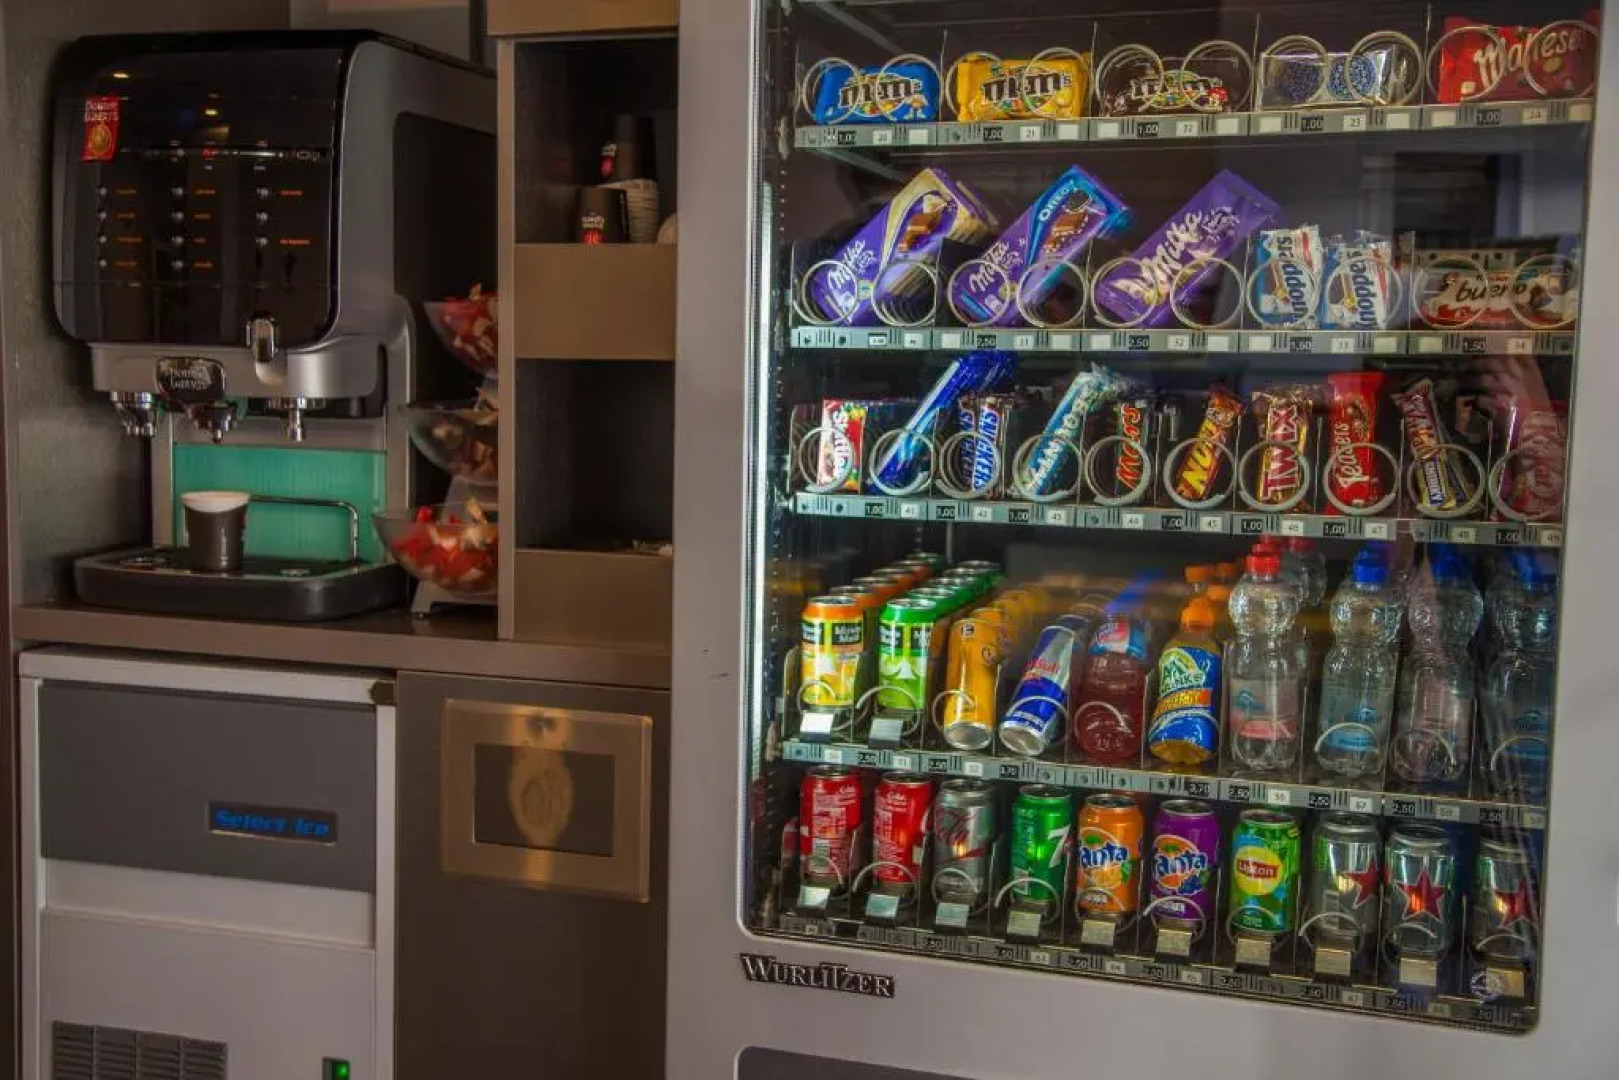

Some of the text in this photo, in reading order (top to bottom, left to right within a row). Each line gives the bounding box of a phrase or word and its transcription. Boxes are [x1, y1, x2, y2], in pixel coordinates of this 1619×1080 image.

[1080, 843, 1128, 868] anta
[1155, 851, 1207, 878] anta
[1238, 860, 1274, 880] Lipton
[739, 953, 895, 998] WURLITZER
